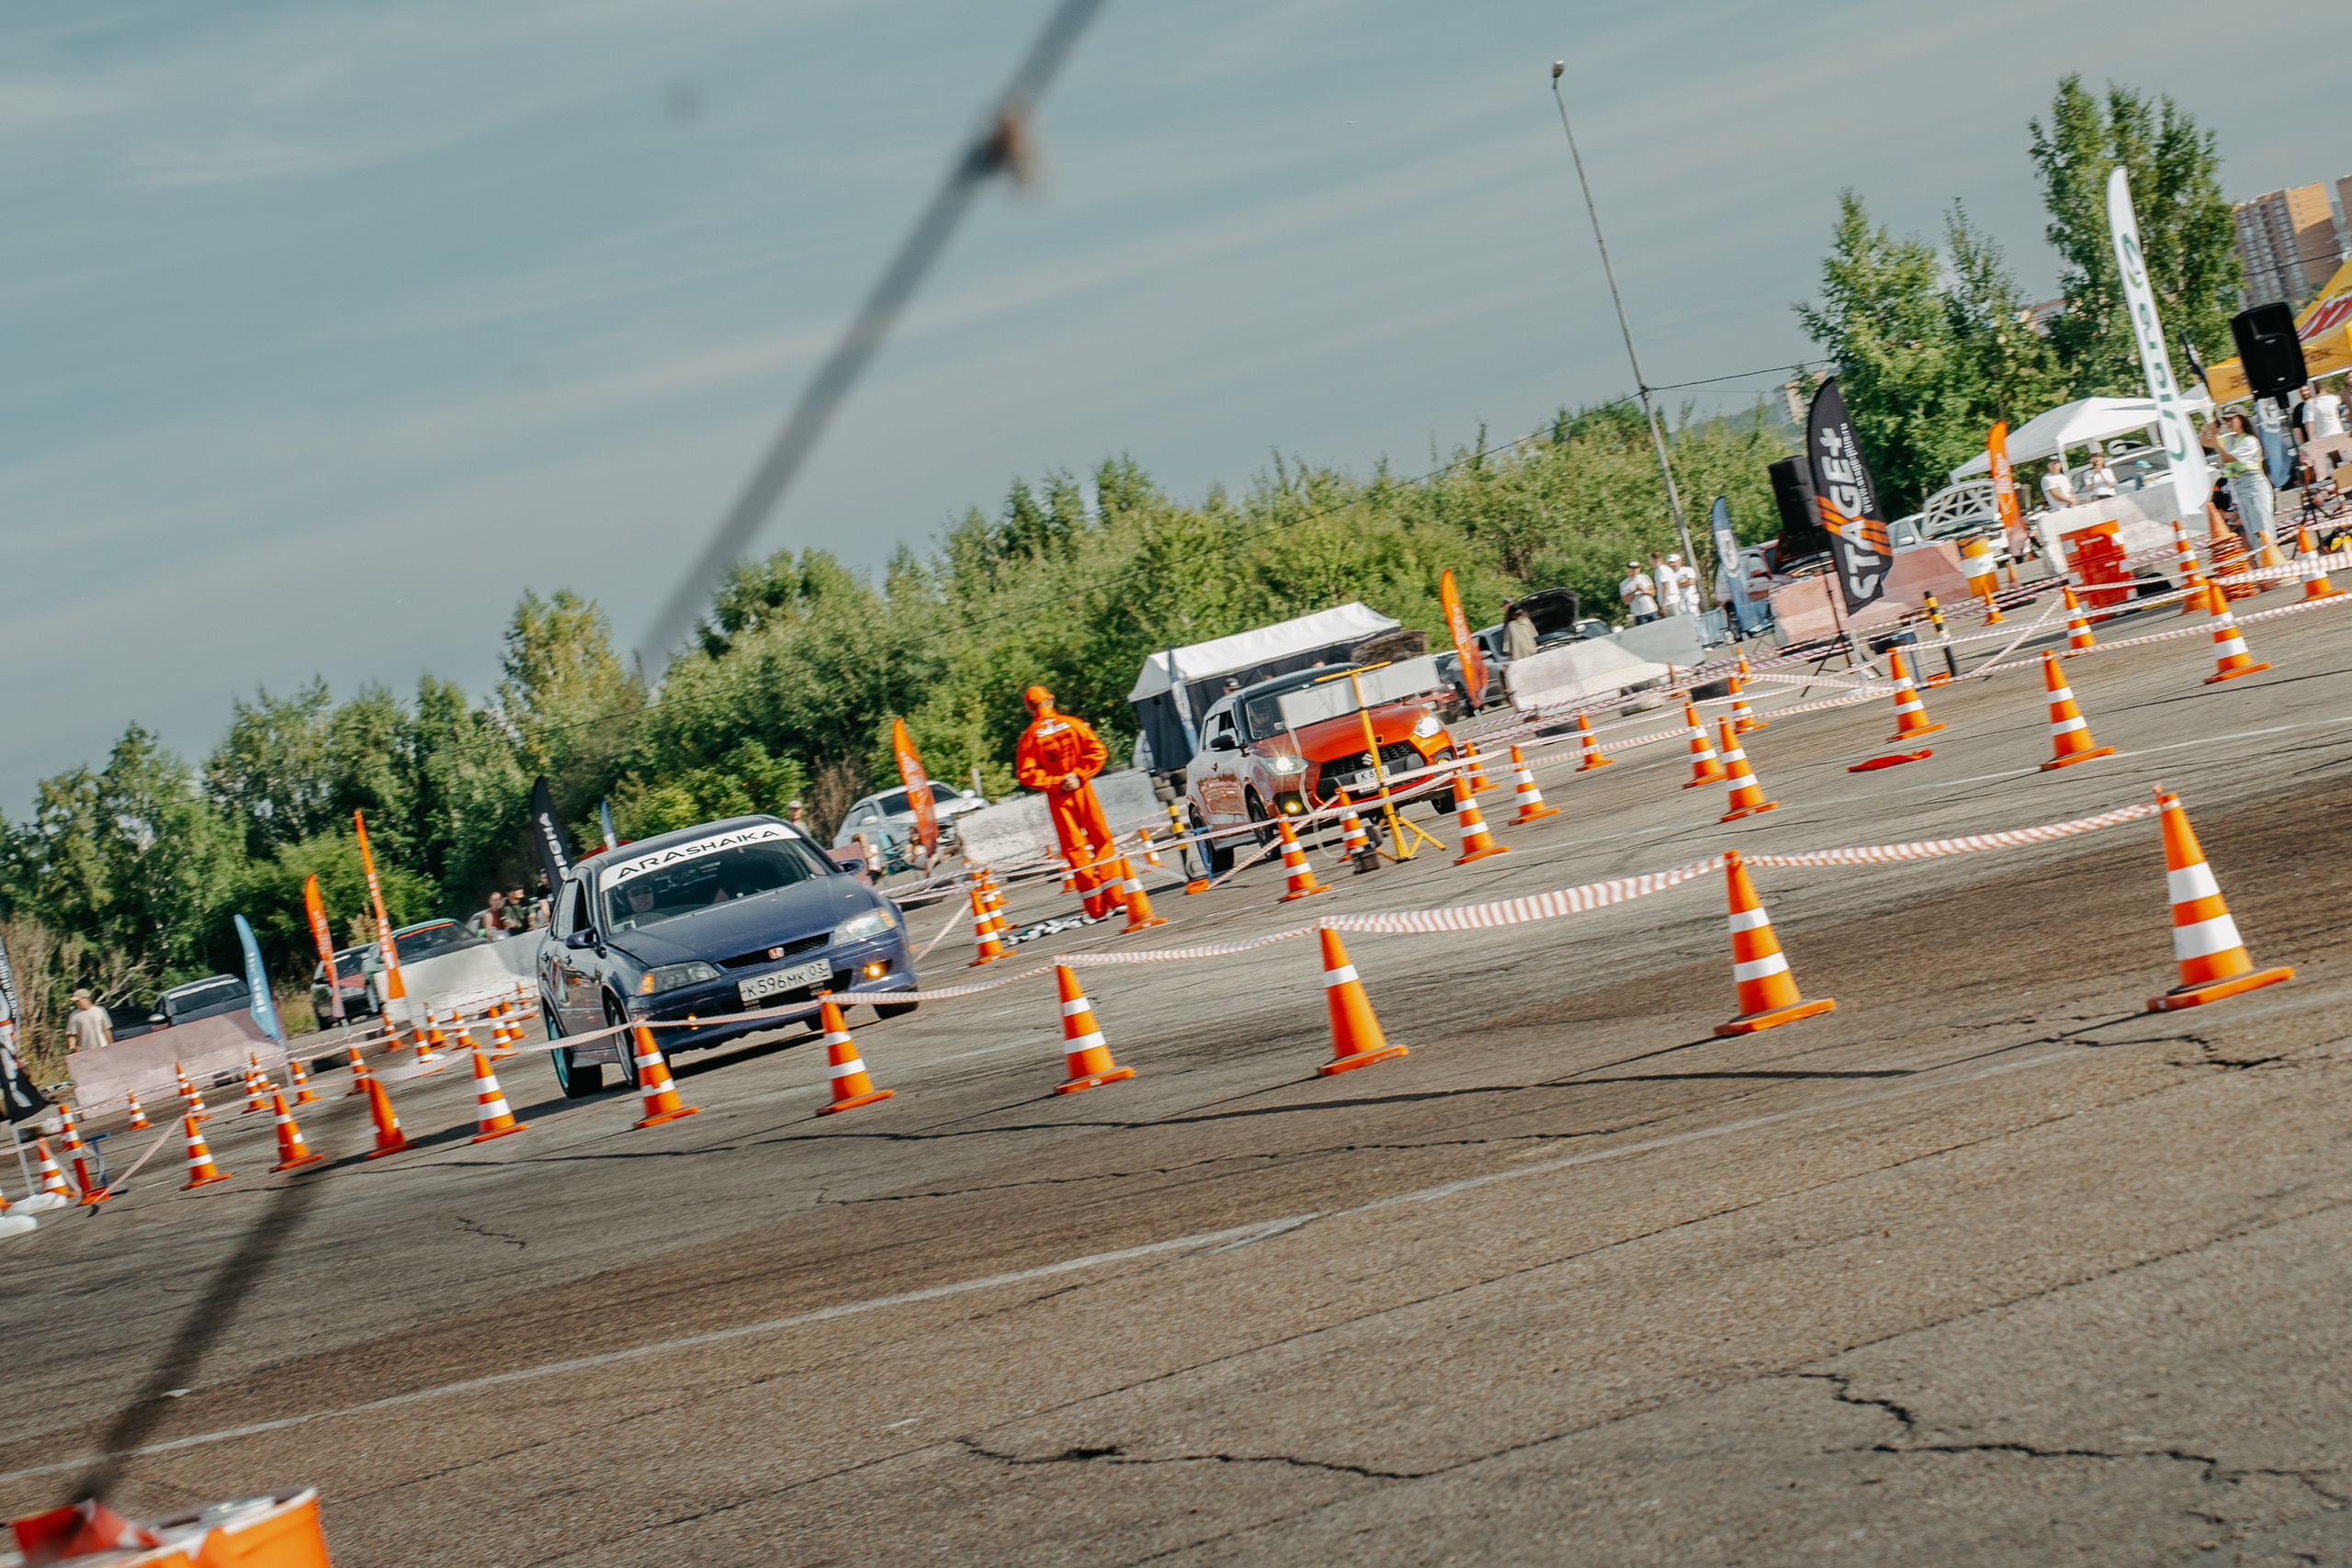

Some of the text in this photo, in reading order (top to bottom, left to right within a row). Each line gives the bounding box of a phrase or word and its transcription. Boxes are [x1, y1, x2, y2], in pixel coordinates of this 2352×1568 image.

[1819, 426, 1882, 600] STAGE+
[538, 812, 571, 881] ОРОНА
[616, 830, 780, 880] ARASHAIKA
